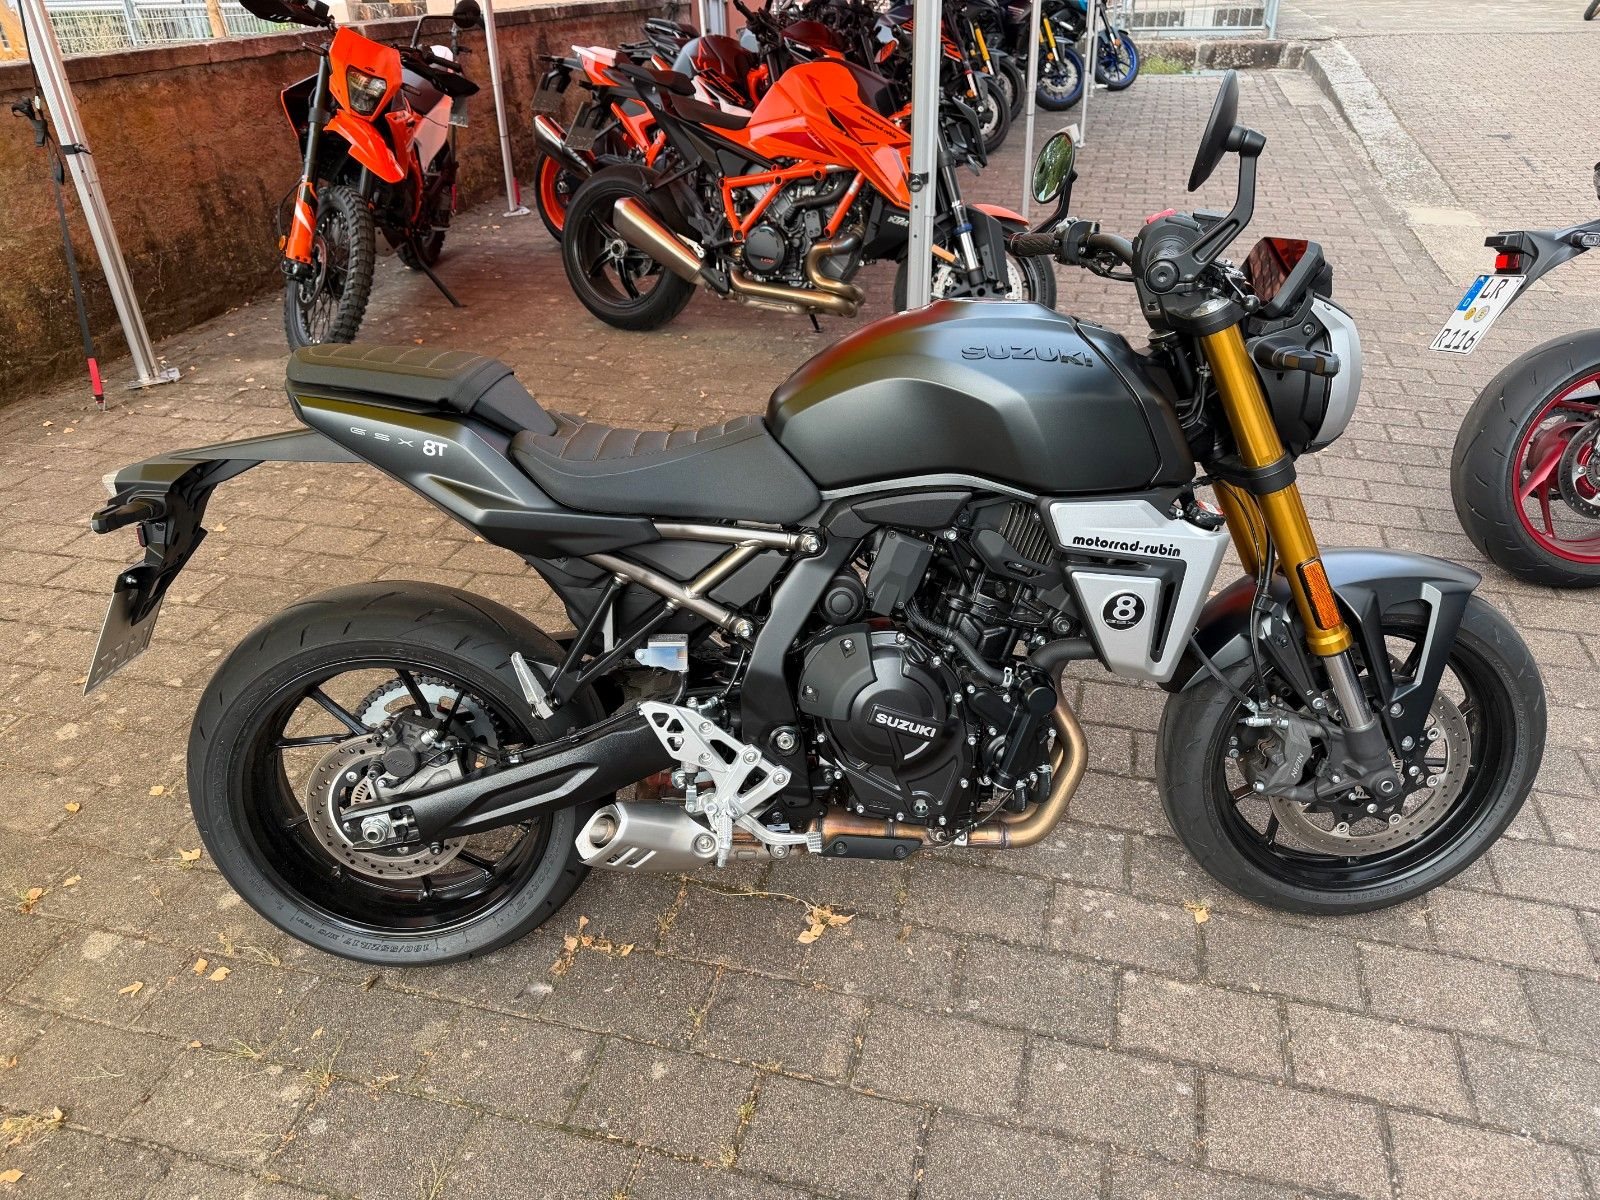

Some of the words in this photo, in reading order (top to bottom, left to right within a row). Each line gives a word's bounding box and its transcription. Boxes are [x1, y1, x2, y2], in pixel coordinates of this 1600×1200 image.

[1480, 278, 1509, 299] LR
[1433, 328, 1480, 350] R116
[961, 344, 1093, 367] SUZUKI
[422, 439, 448, 457] 8T
[1072, 535, 1181, 557] motorrad-rubin
[1112, 595, 1137, 620] 8
[875, 713, 937, 738] SUZUKI
